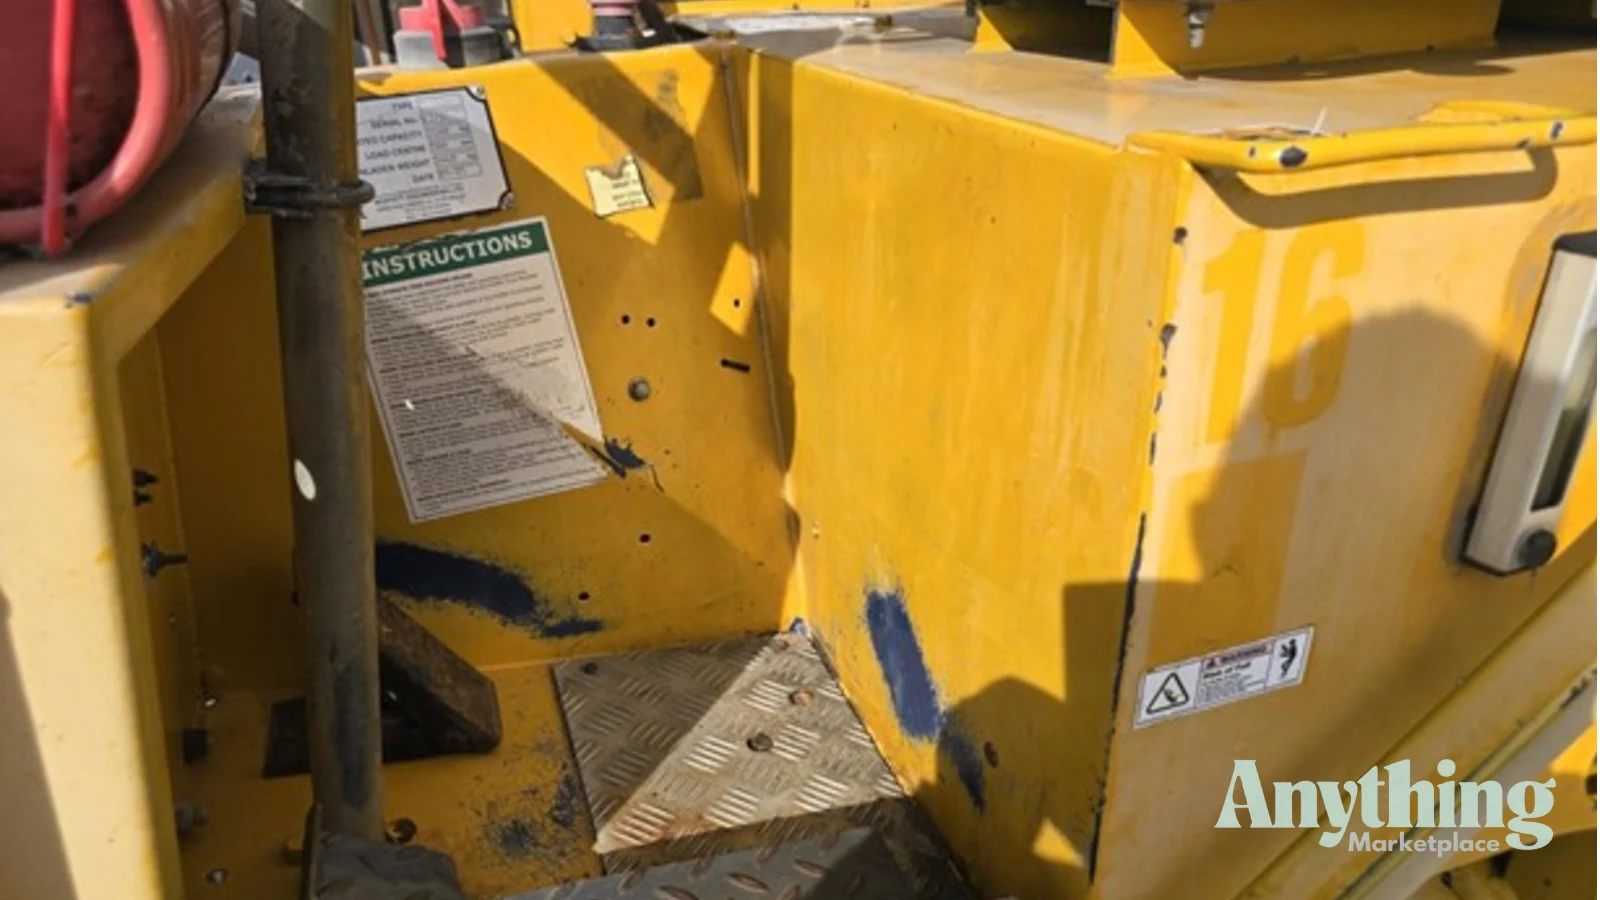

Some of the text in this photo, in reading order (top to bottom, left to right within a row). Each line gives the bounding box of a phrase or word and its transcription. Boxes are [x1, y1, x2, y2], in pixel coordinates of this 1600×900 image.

[391, 102, 414, 112] TYPE
[380, 130, 422, 143] CAPACITY
[365, 151, 389, 160] LOAD
[397, 159, 430, 171] WEIGHT
[411, 173, 434, 183] DATE
[361, 230, 533, 280] INSTRUCTIONS
[1203, 221, 1364, 444] 16
